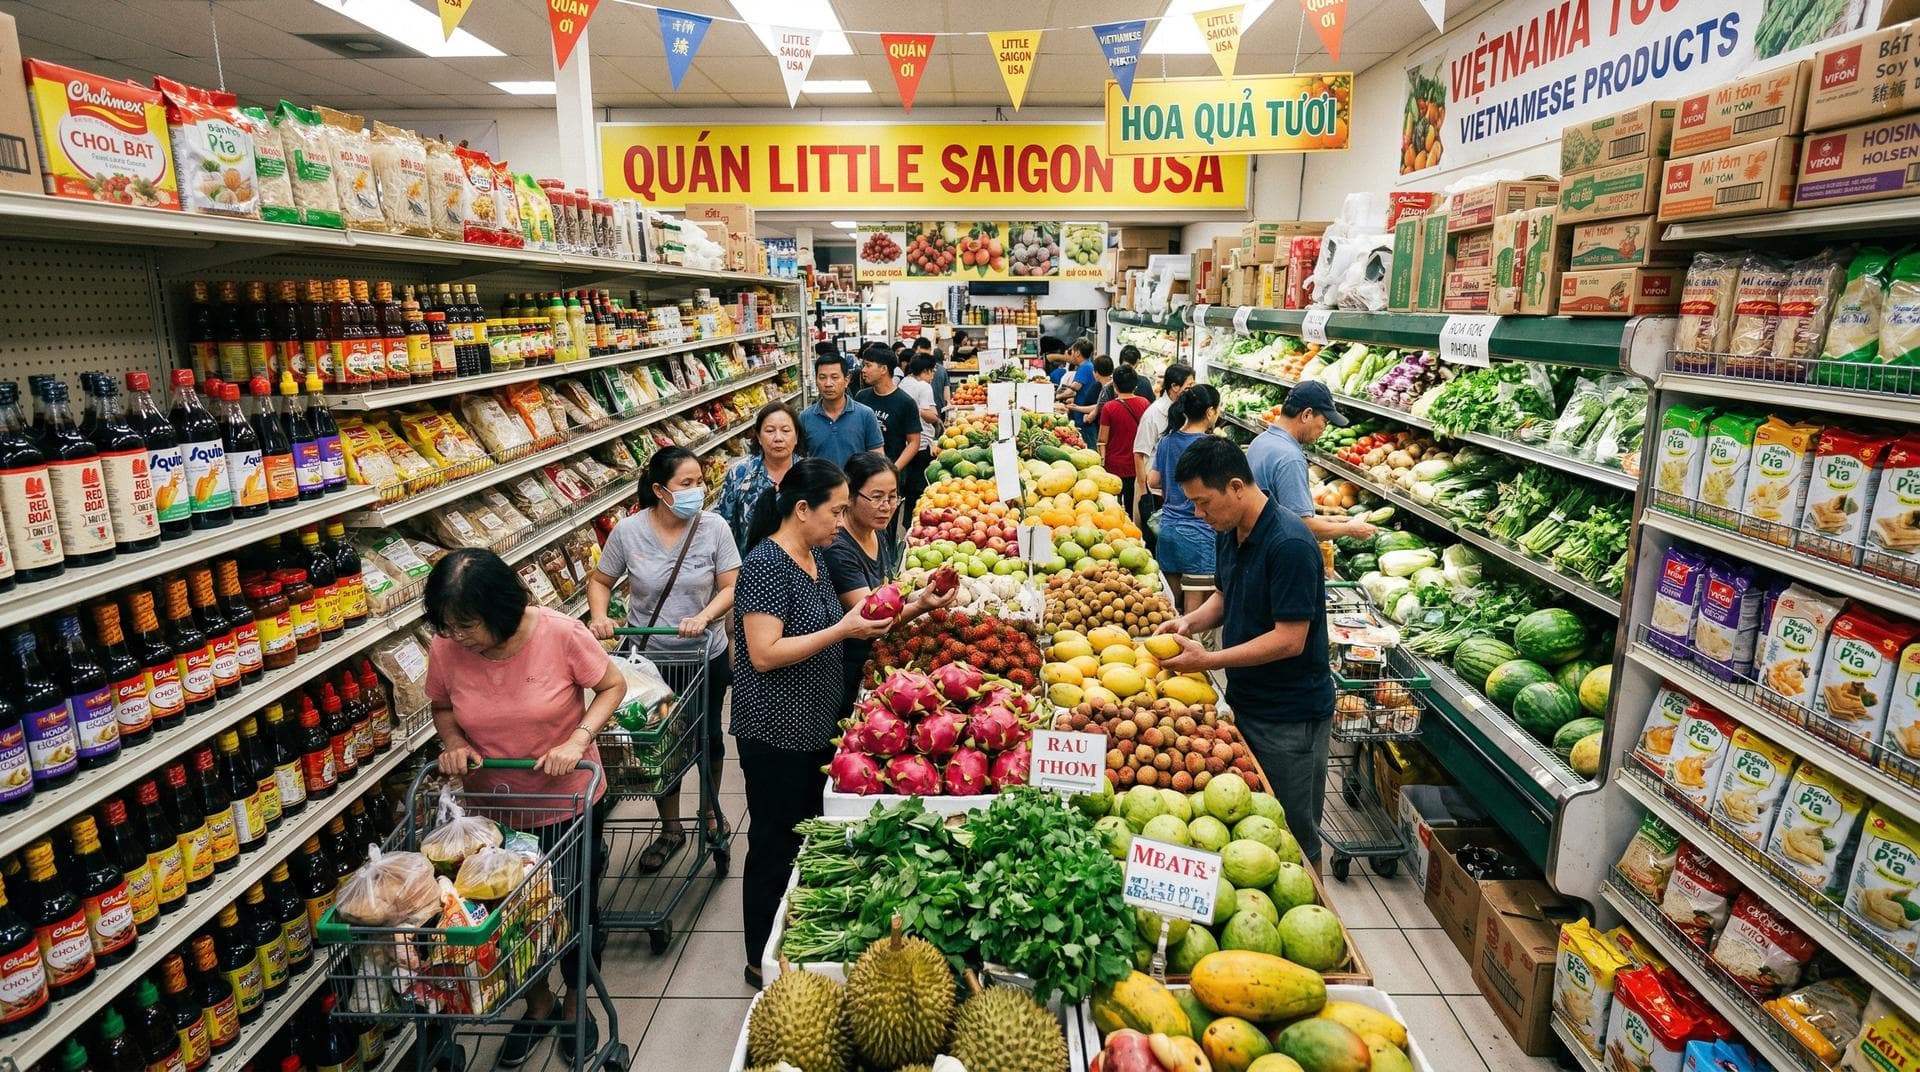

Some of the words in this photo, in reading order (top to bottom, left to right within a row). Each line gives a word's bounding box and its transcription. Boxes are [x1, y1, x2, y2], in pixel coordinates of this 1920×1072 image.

[1207, 13, 1235, 26] LITTLE
[782, 33, 811, 46] LITTLE
[1001, 38, 1029, 49] LITTLE
[1215, 41, 1233, 53] USA
[780, 46, 812, 59] SAIGON
[889, 40, 927, 59] QUÁN
[1000, 50, 1032, 63] SAIGON
[786, 60, 804, 71] USA
[1007, 64, 1025, 75] USA
[1460, 75, 1577, 144] VIETNAMESE
[1582, 12, 1740, 105] PRODUCTS
[1824, 68, 1856, 85] VIFON
[67, 79, 145, 117] Cholimex
[1121, 103, 1185, 142] HOA
[1193, 87, 1252, 146] QUẢ
[1265, 92, 1338, 138] TƯƠI
[70, 130, 120, 154] CHOL
[123, 140, 154, 160] BAT
[622, 130, 749, 201] QUÁN
[768, 144, 924, 193] LITTLE
[939, 144, 1113, 194] SAIGON
[1133, 152, 1225, 194] USA
[1809, 155, 1840, 169] VIFON
[1827, 463, 1850, 481] Pía
[85, 489, 103, 501] RED
[29, 499, 49, 512] RED
[84, 498, 105, 512] BOAT
[28, 509, 52, 524] BOAT
[1047, 736, 1089, 754] RAU
[1037, 758, 1097, 778] THƠM
[51, 944, 78, 960] CHOL
[2, 975, 31, 992] CHOL
